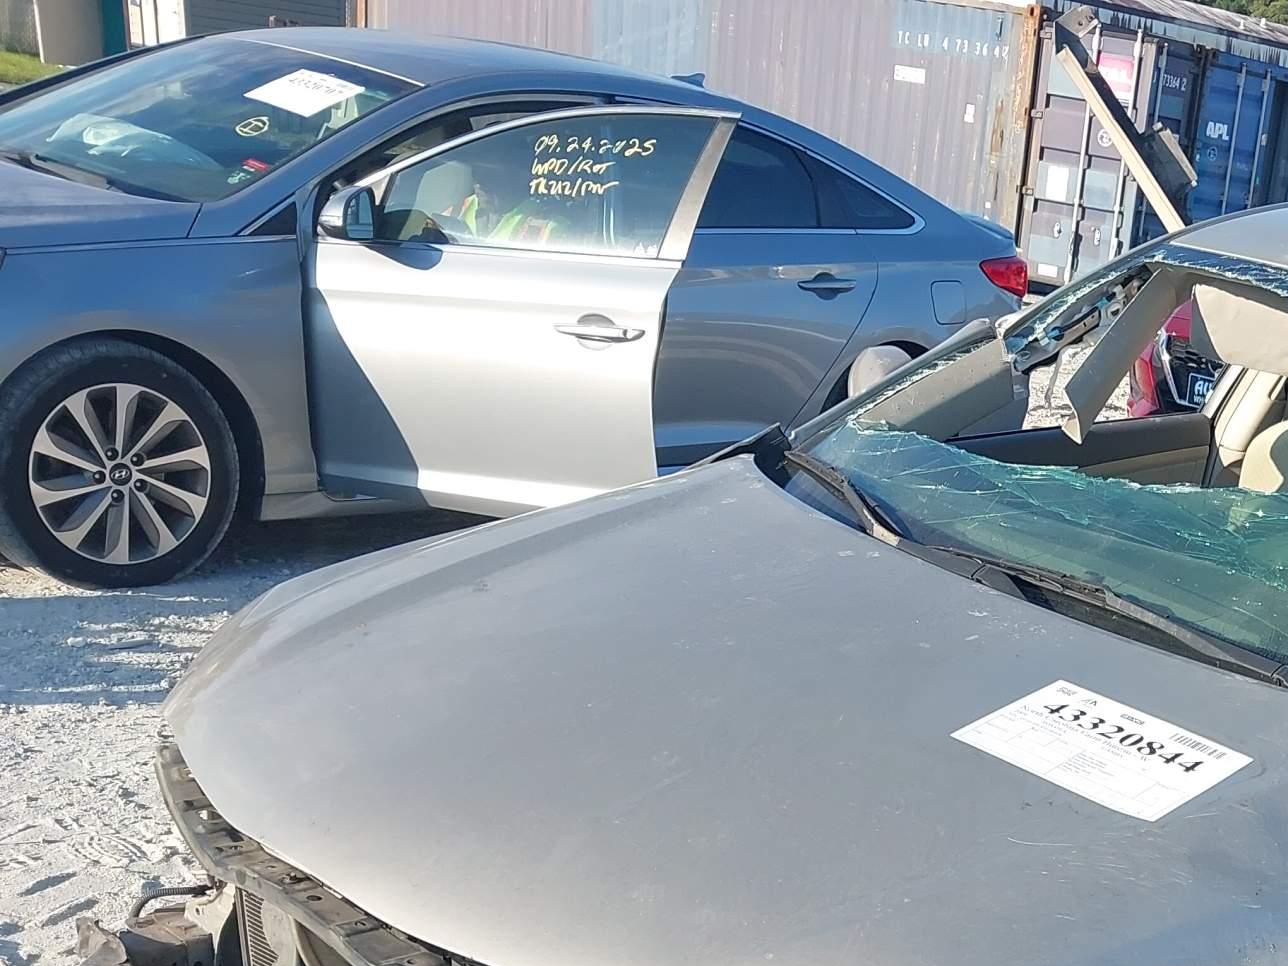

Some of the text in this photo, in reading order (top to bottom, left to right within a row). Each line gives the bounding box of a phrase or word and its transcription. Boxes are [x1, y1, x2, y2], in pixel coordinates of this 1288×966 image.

[1206, 121, 1229, 140] APL
[534, 134, 657, 157] 09.24.2025
[1043, 703, 1204, 773] 43320844
